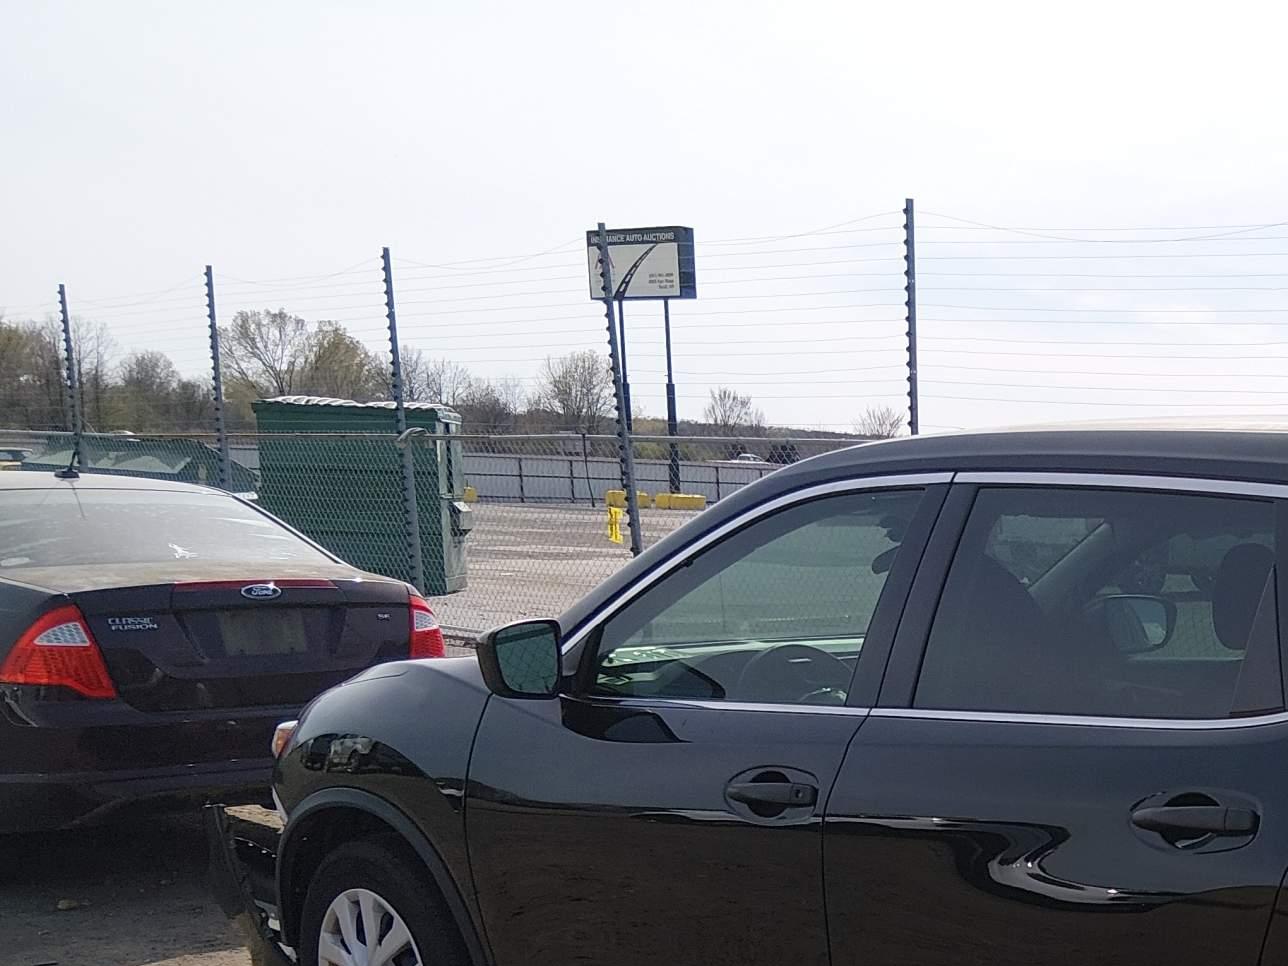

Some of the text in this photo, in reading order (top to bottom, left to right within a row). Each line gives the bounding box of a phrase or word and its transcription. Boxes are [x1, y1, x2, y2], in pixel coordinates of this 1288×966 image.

[590, 231, 675, 244] INSANCE AUTO AUCTIONS
[111, 623, 158, 631] FUSION
